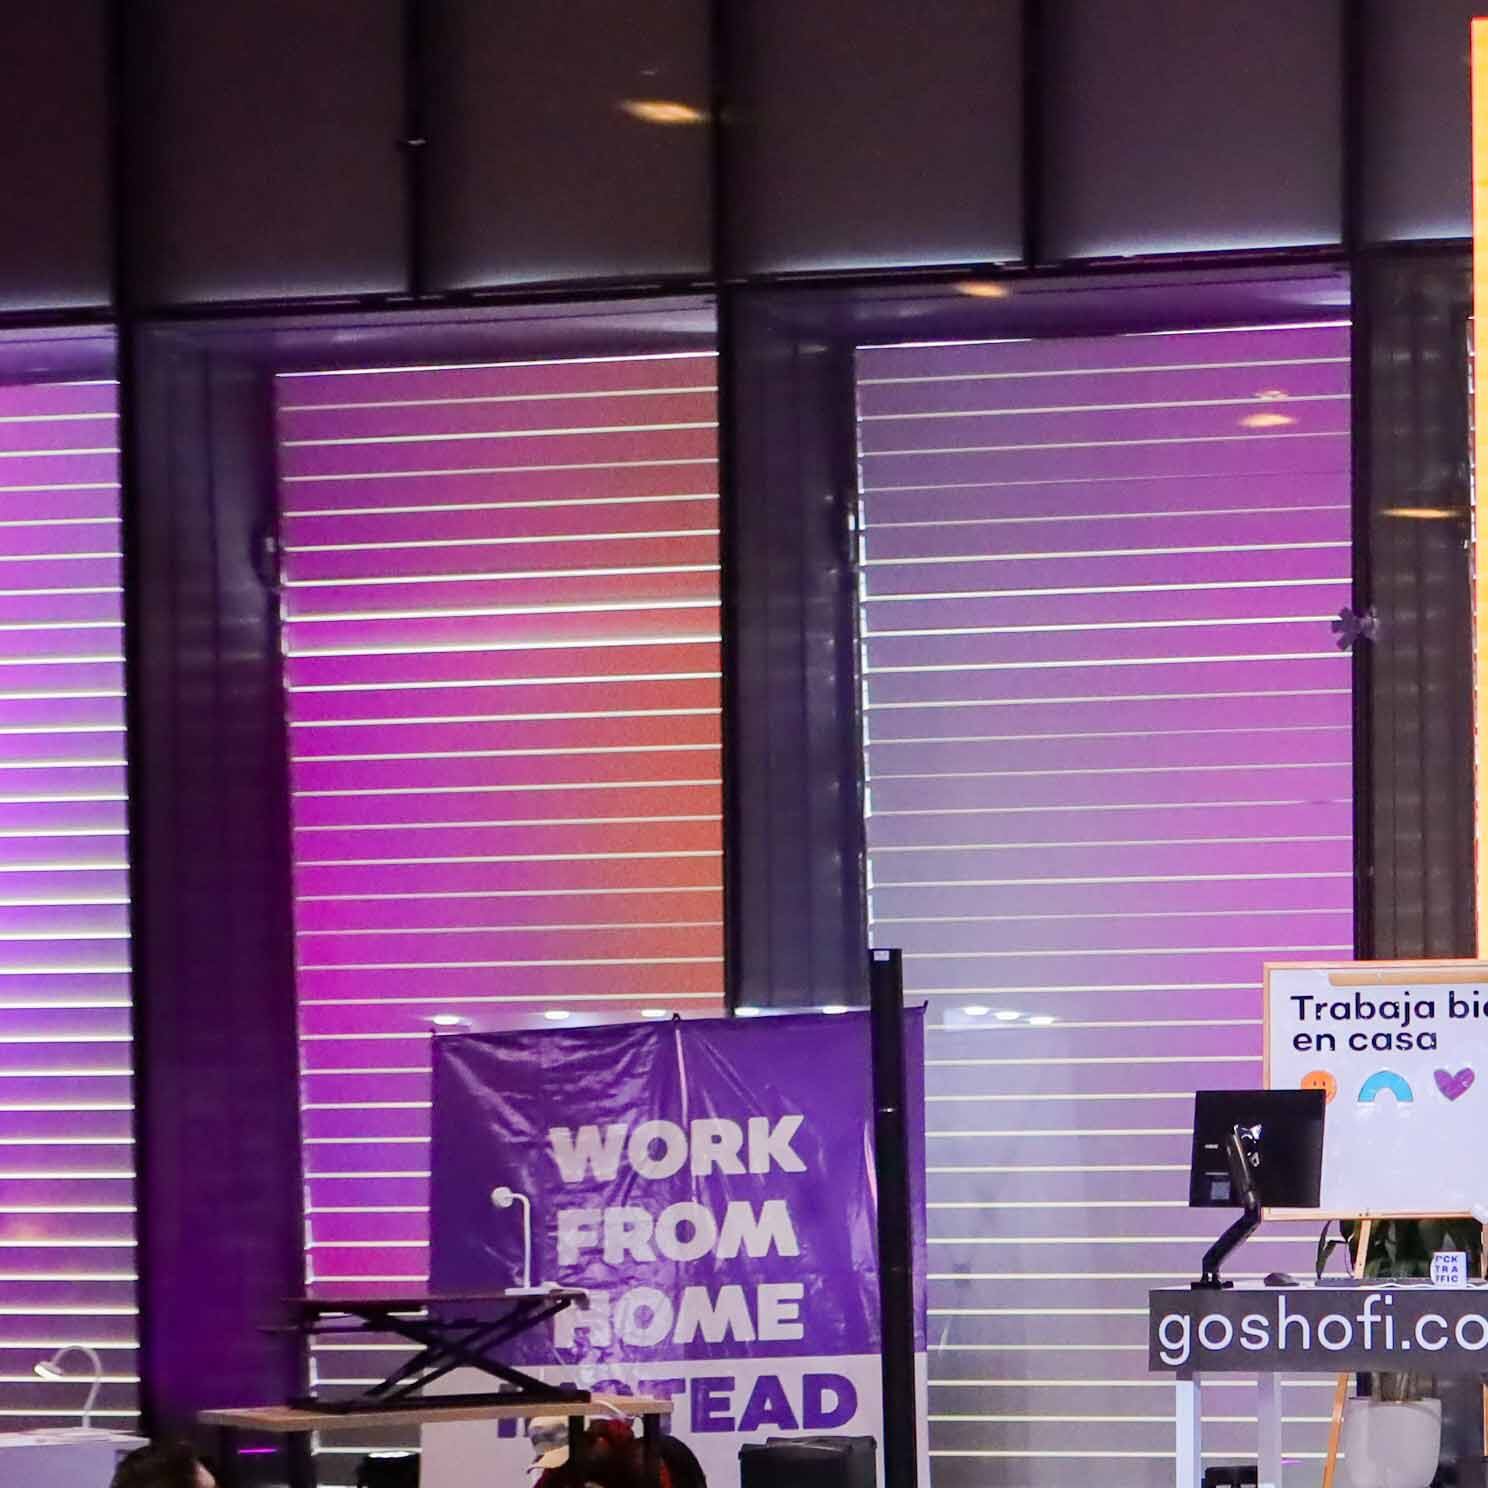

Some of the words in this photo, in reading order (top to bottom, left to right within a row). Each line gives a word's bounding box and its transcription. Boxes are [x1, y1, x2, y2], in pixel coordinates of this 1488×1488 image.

[1290, 991, 1435, 1027] Trabaja
[1293, 1033, 1336, 1051] en
[1349, 1032, 1437, 1051] casa
[549, 1115, 807, 1183] WORK
[556, 1200, 800, 1266] FROM
[553, 1283, 804, 1348] HOME
[497, 1373, 858, 1439] ITEAD
